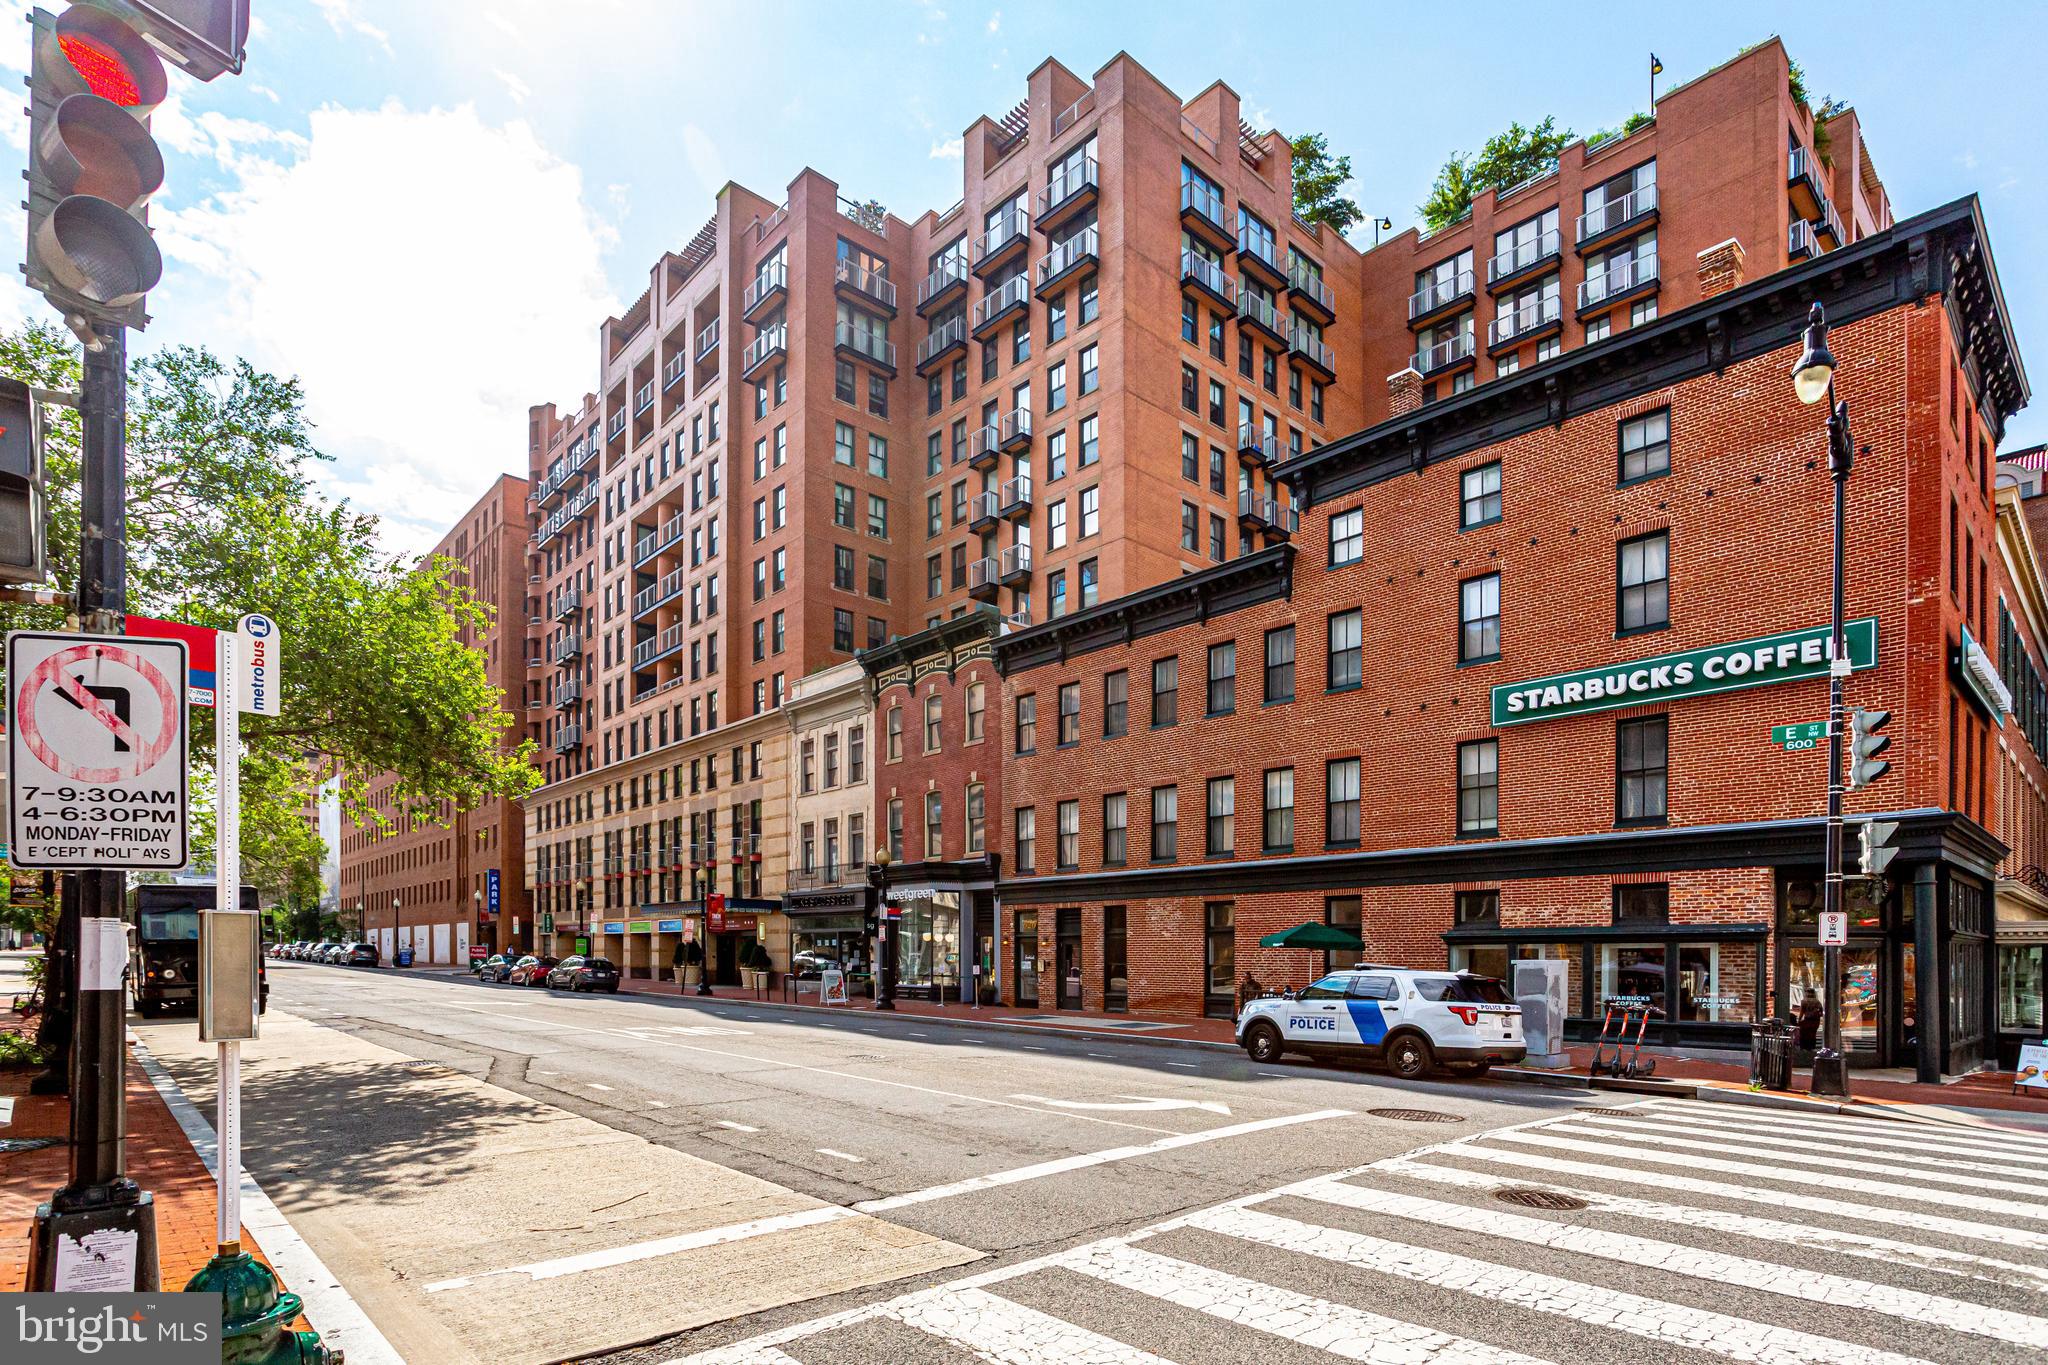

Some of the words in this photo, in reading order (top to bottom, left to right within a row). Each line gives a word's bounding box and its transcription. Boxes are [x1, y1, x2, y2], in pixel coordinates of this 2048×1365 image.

[250, 640, 265, 711] metrobus
[1506, 662, 1694, 713] STARBUCKS
[1785, 726, 1797, 740] E
[1786, 739, 1813, 750] 600
[22, 786, 175, 804] 7-9:30AM
[22, 806, 176, 824] 4-6:30PM
[26, 825, 172, 843] MONDAY-FRIDAY
[28, 846, 88, 858] ECEPT
[94, 847, 171, 860] HOLIAYS
[866, 922, 875, 930] sg
[1290, 1018, 1336, 1031] POLICE
